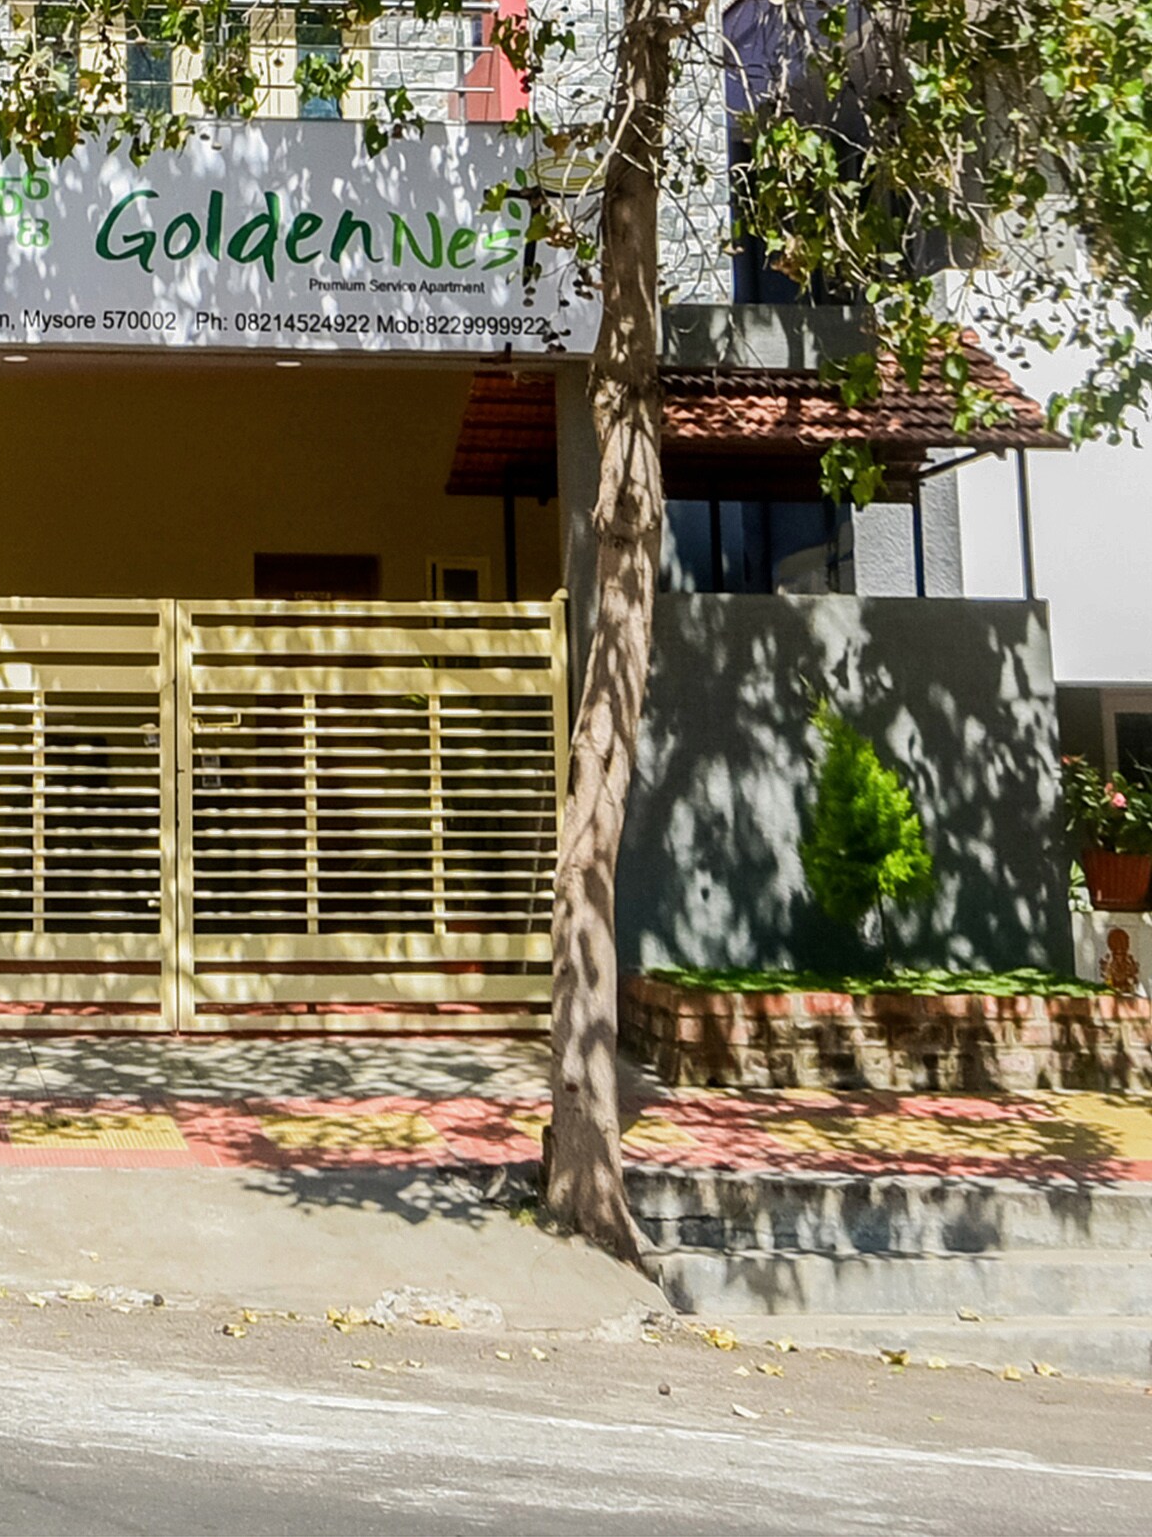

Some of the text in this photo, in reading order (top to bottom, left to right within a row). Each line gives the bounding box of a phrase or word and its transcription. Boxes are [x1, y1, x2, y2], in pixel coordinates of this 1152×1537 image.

[308, 277, 486, 296] Premium Service Apartment
[22, 309, 97, 333] Mysore
[102, 310, 177, 331] 570002
[195, 312, 228, 332] Ph:
[234, 312, 371, 334] 08214524922
[376, 315, 548, 337] Mob:8229999922
